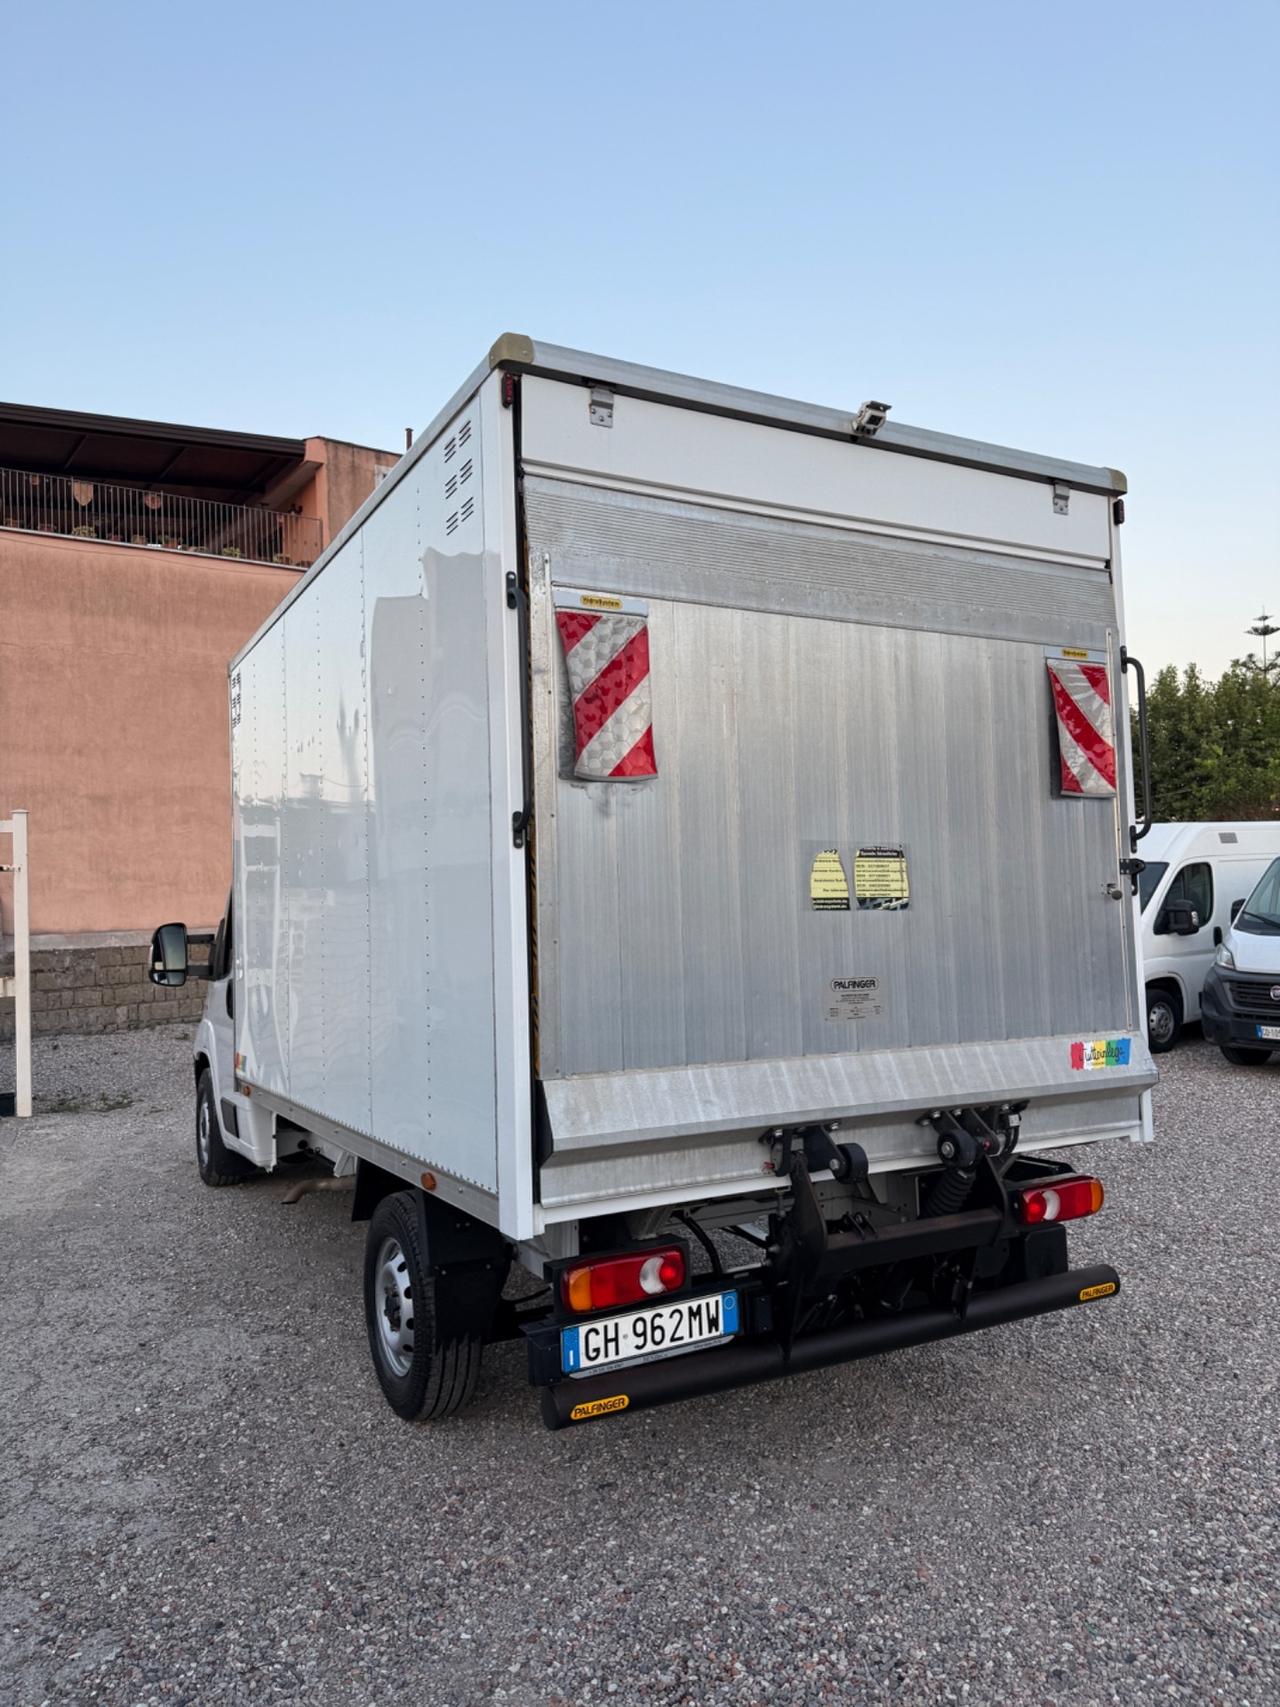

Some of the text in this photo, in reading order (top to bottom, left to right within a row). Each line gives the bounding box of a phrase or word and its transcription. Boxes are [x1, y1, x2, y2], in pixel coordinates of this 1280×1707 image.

[833, 979, 876, 990] PALFINGER
[584, 1322, 620, 1362] GH
[632, 1299, 721, 1351] 962MW
[573, 1397, 627, 1418] PALFINGER
